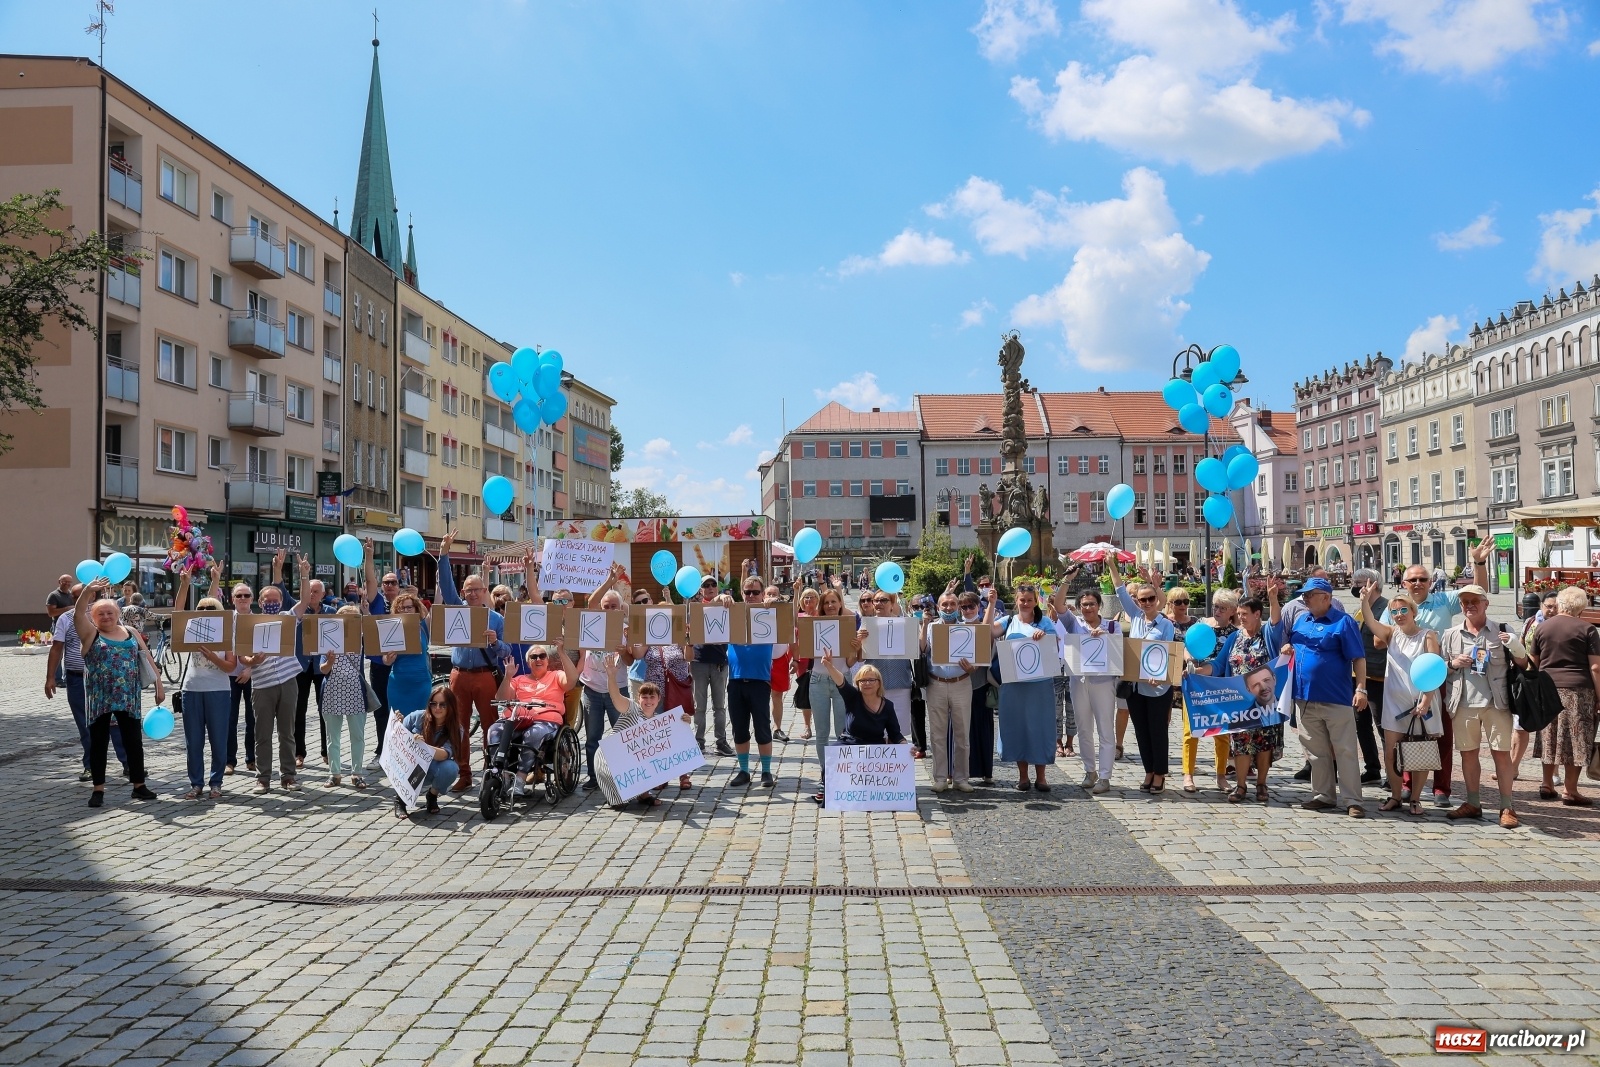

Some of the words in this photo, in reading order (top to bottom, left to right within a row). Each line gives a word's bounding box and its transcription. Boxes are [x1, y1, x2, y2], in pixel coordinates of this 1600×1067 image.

[255, 532, 301, 547] JUBILER
[315, 565, 334, 574] CASIO
[543, 572, 557, 585] NIE
[1191, 696, 1219, 706] Wspólna
[1220, 693, 1244, 702] Polska
[1192, 701, 1278, 728] TRZASKOW
[620, 713, 676, 744] LEKARSTWEM
[627, 740, 640, 753] NA
[642, 727, 672, 747] NASZE
[633, 738, 672, 762] TROSKI
[838, 746, 853, 759] NA
[858, 746, 897, 759] FILOKA
[614, 766, 652, 790] RAFAŁ
[649, 747, 701, 774] TRZASKOWSKI
[836, 761, 853, 774] NIE
[856, 761, 908, 773] GŁOSUJEMY
[850, 773, 900, 787] RAFAŁOWI
[834, 790, 867, 802] DOBRZE
